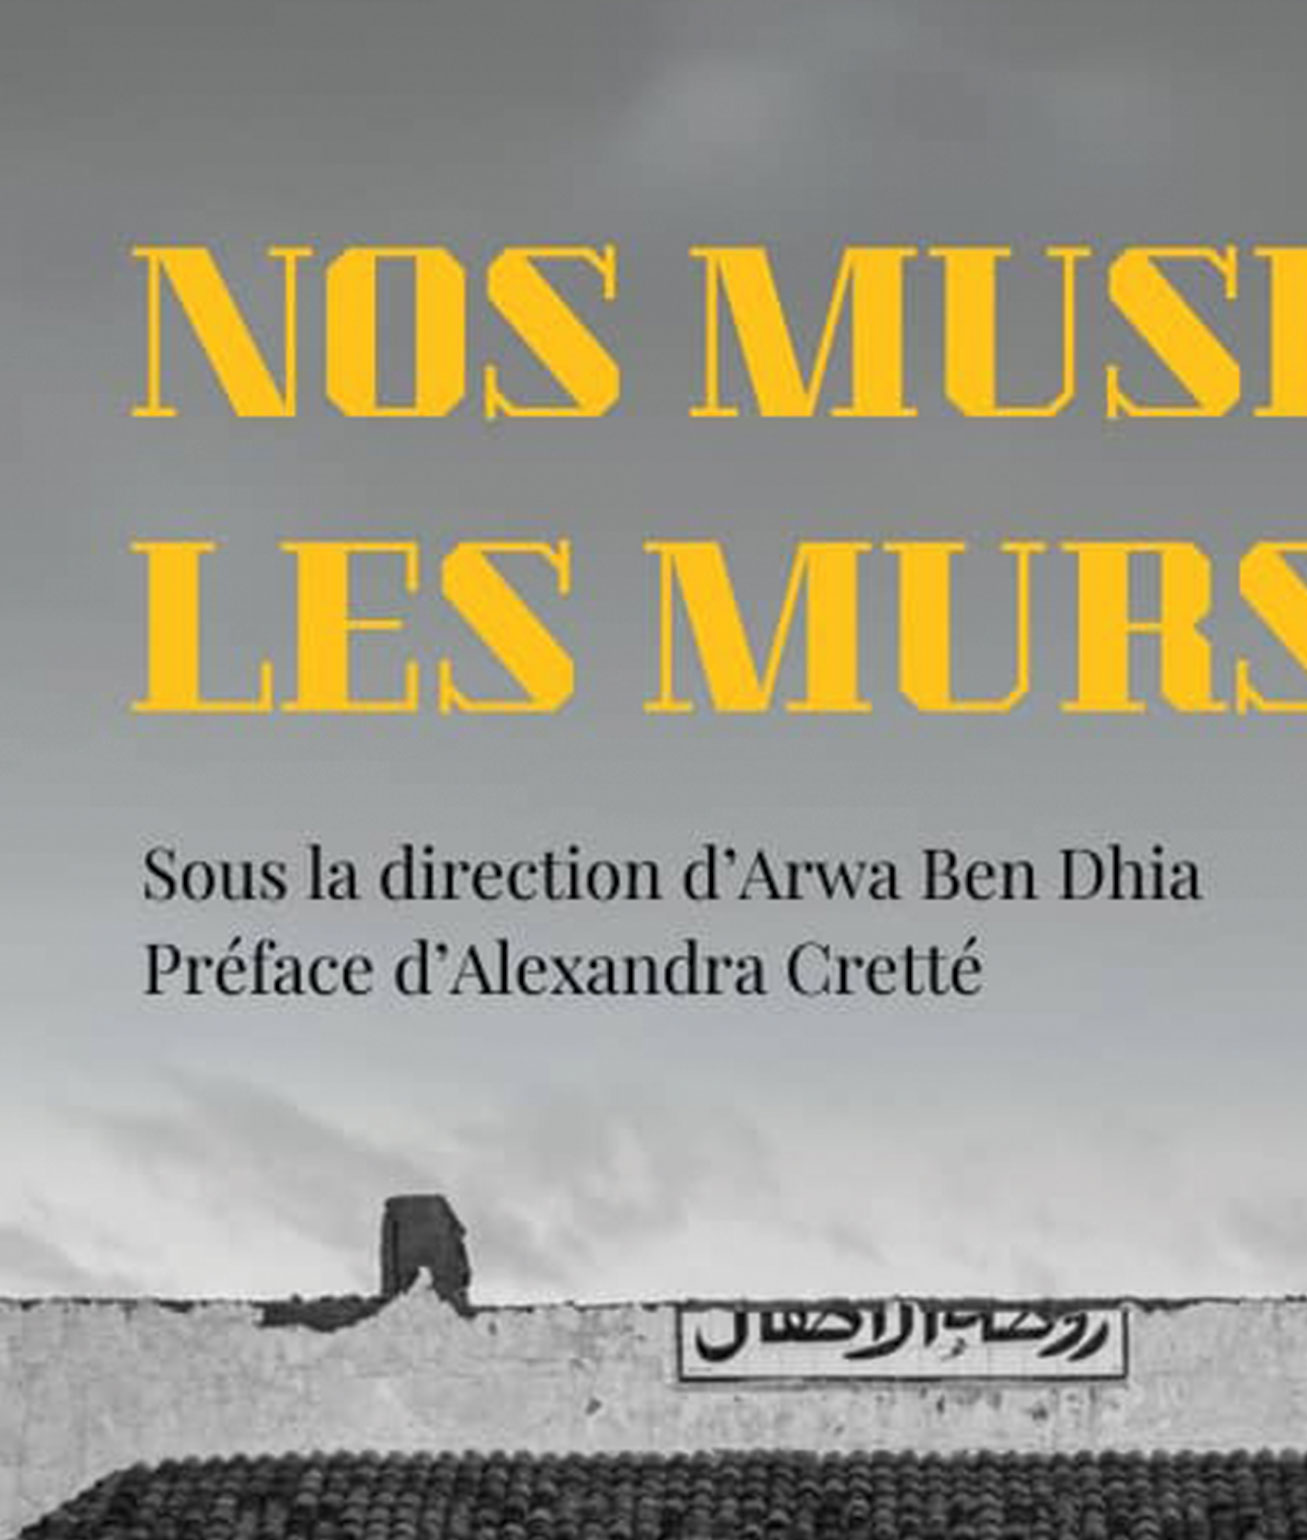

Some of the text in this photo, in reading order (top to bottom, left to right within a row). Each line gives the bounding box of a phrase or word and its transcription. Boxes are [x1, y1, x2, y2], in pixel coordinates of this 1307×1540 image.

[132, 244, 621, 417] NOS
[132, 539, 574, 715] LES
[143, 846, 288, 901] Sous
[309, 843, 359, 901] la
[379, 843, 662, 901] direction
[923, 849, 1038, 901] Ben
[1060, 843, 1202, 901] Dhia
[145, 936, 374, 996] Préface
[787, 936, 983, 996] Cretté
